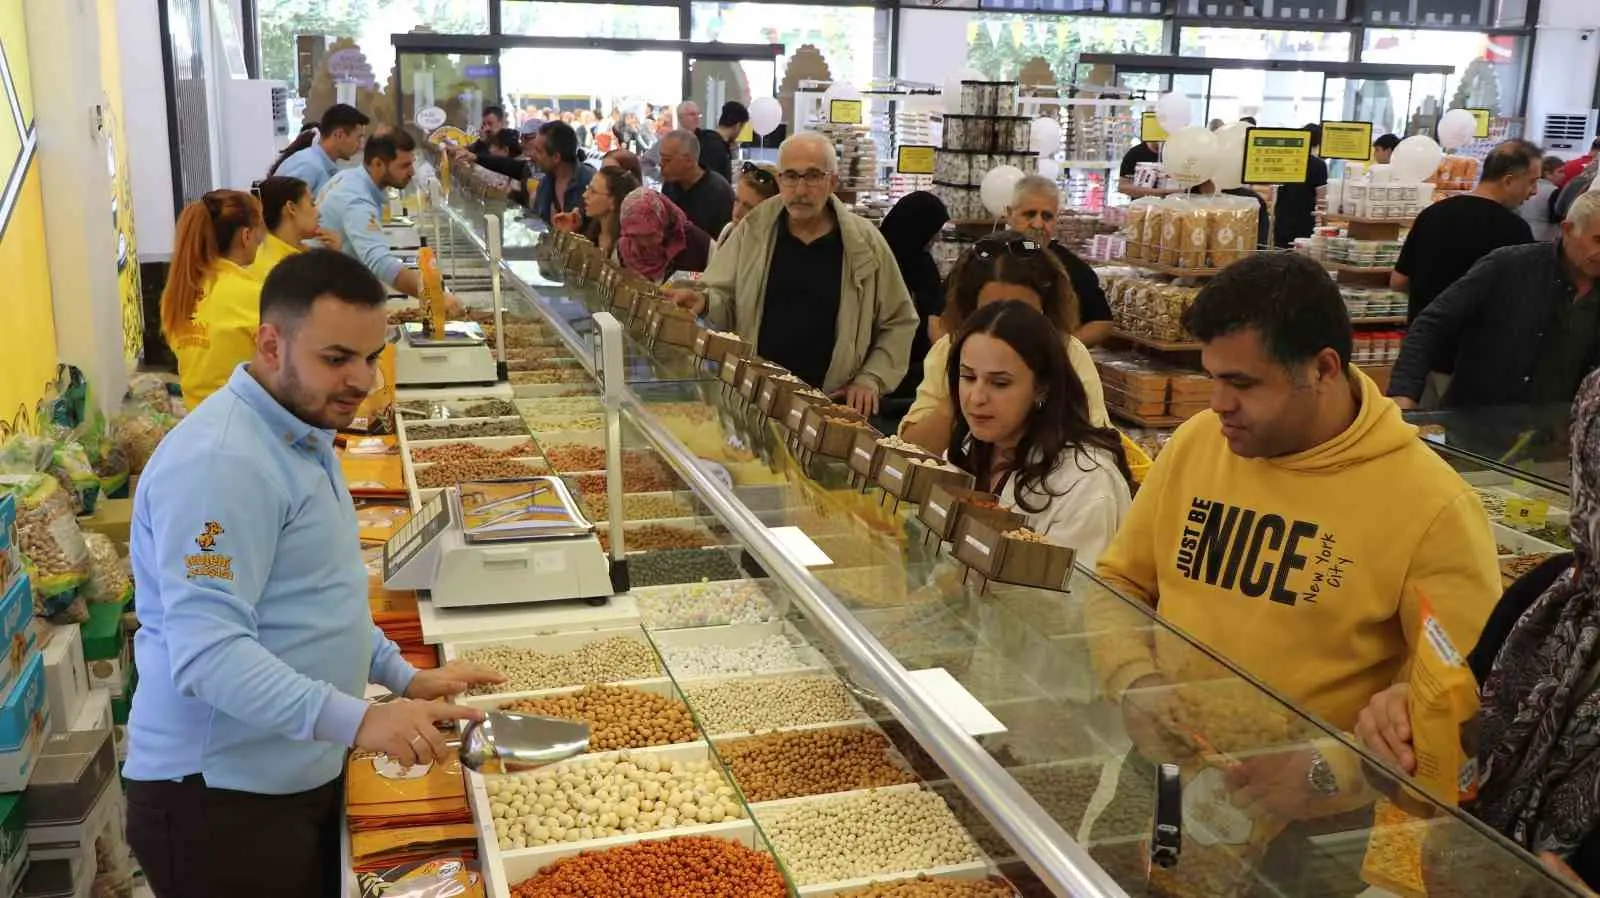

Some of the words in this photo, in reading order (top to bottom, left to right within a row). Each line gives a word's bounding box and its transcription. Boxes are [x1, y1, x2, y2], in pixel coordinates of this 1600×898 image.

[1188, 496, 1212, 525] BE
[1177, 525, 1200, 579] JUST
[1190, 500, 1319, 606] NICE
[1303, 571, 1324, 604] New
[1315, 532, 1337, 565] York
[1327, 555, 1355, 588] City
